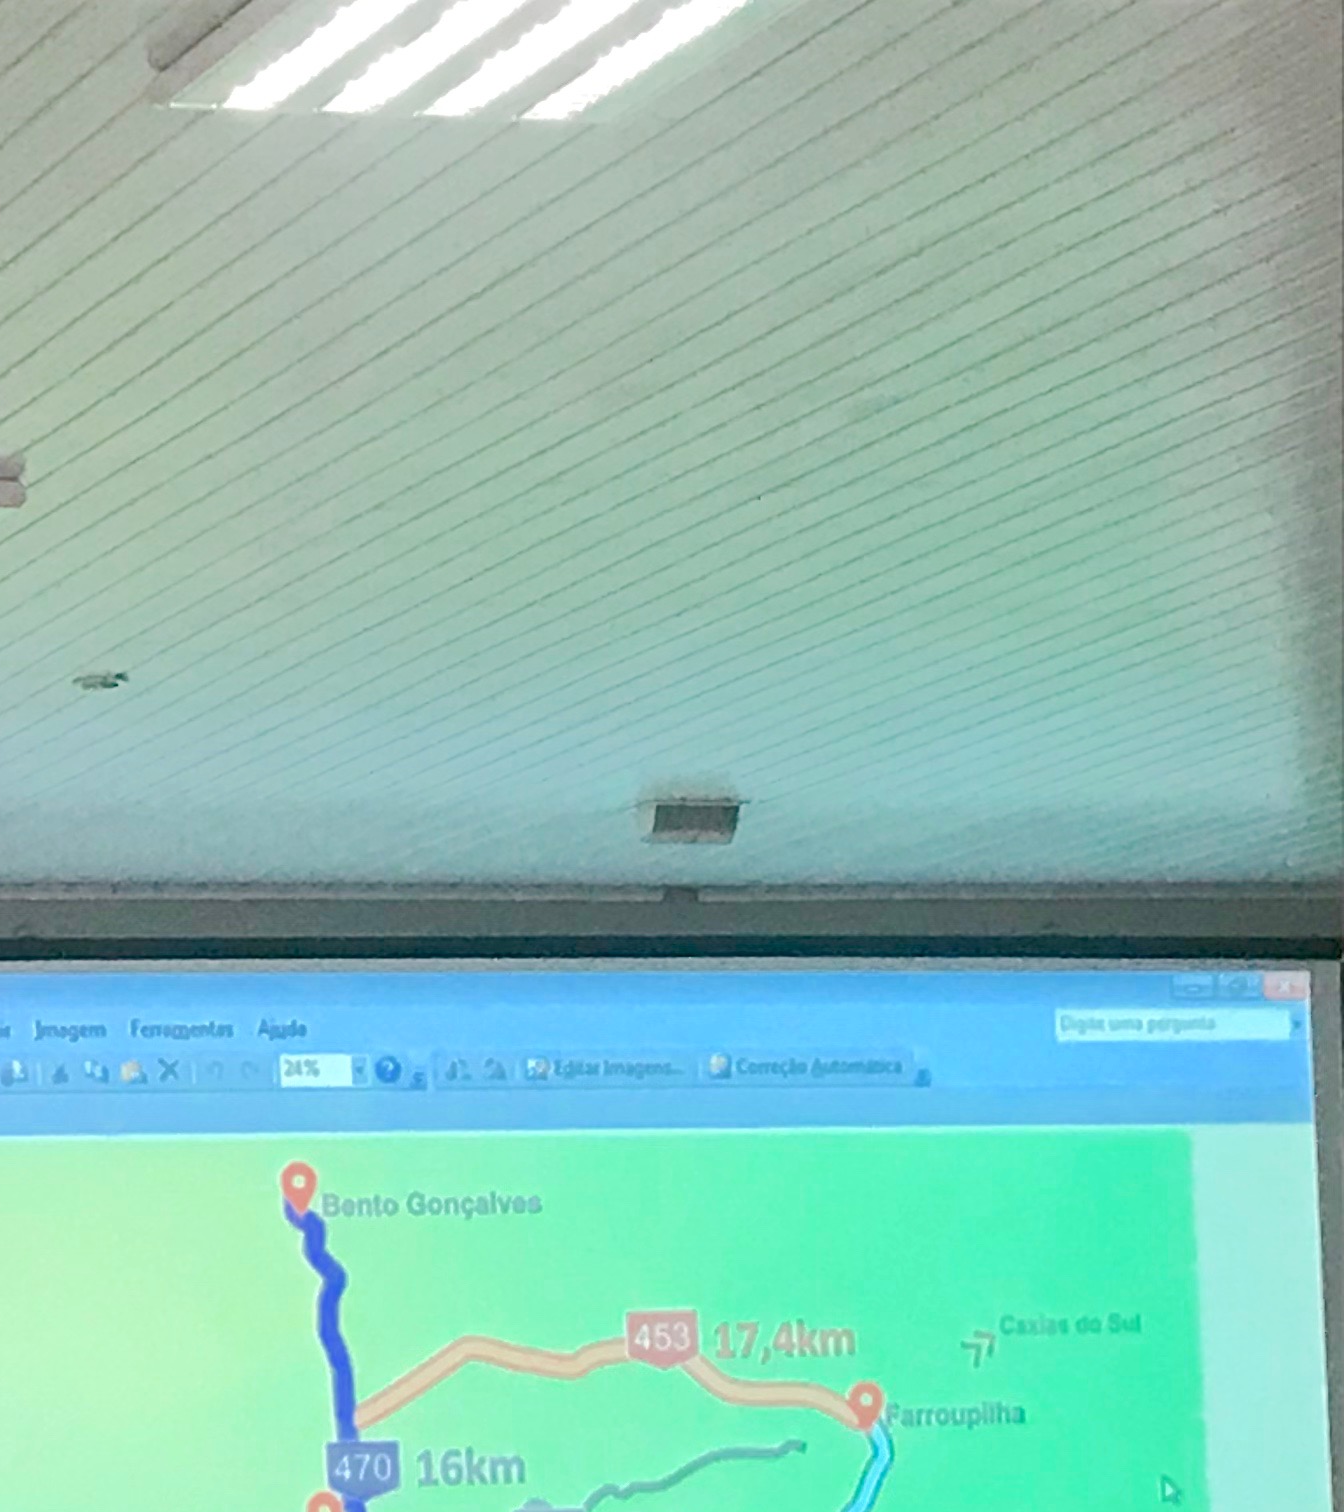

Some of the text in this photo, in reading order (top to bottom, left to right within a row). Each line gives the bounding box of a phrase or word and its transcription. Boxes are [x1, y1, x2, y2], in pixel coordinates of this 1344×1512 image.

[321, 1190, 543, 1221] Bento Gonçalves
[634, 1323, 692, 1352] 453
[1109, 1313, 1142, 1333] Sul
[713, 1321, 857, 1364] 17,4km
[886, 1402, 1026, 1428] Farroupilha
[333, 1452, 393, 1482] 470
[416, 1446, 527, 1488] 16km
